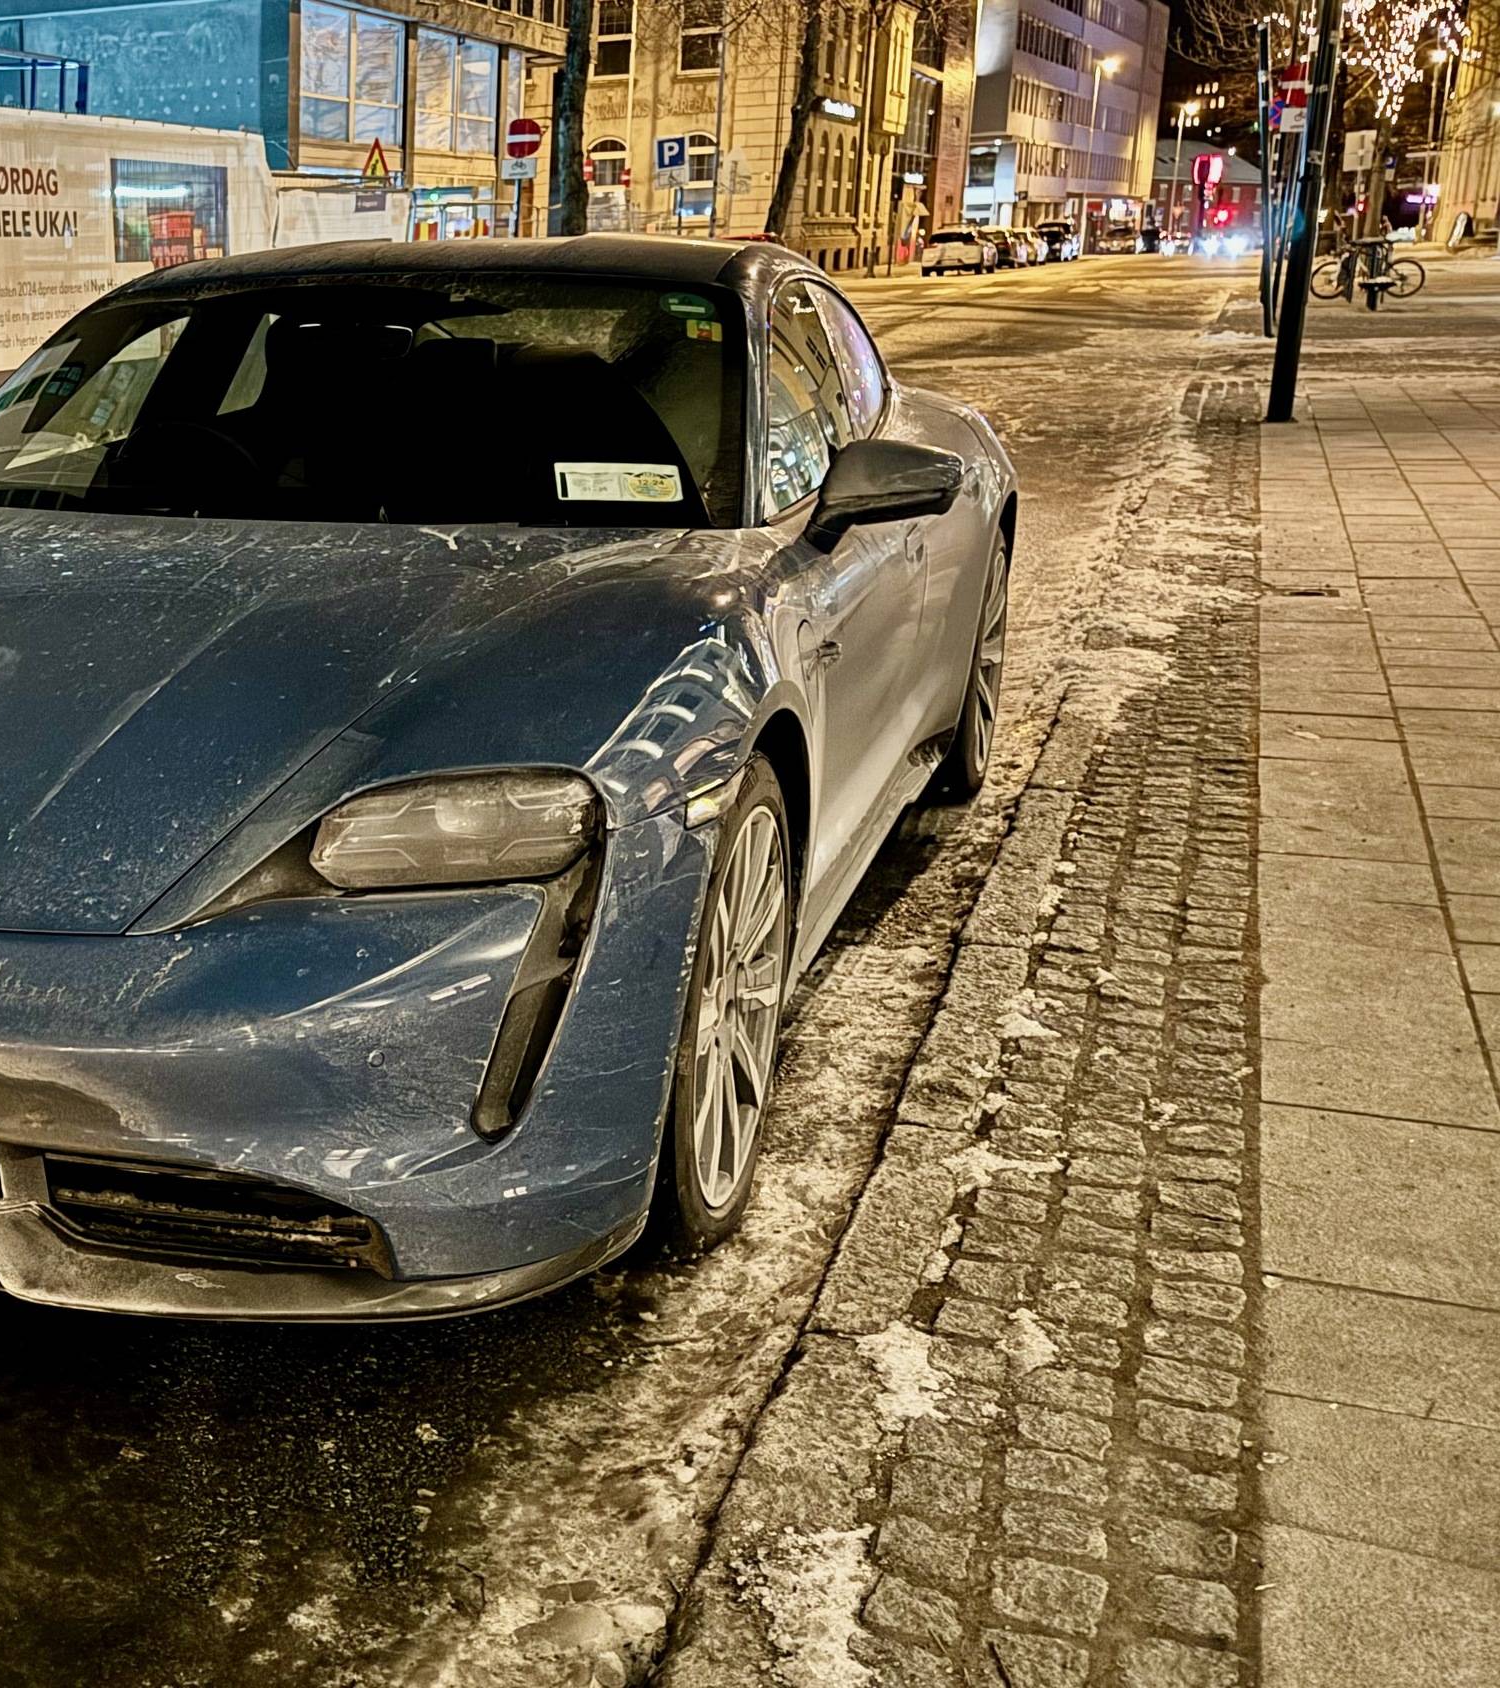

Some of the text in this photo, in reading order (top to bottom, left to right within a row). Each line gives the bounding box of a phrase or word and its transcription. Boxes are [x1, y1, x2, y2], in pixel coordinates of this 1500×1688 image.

[663, 141, 680, 166] P
[35, 209, 78, 238] UKA!
[17, 281, 37, 297] 2024
